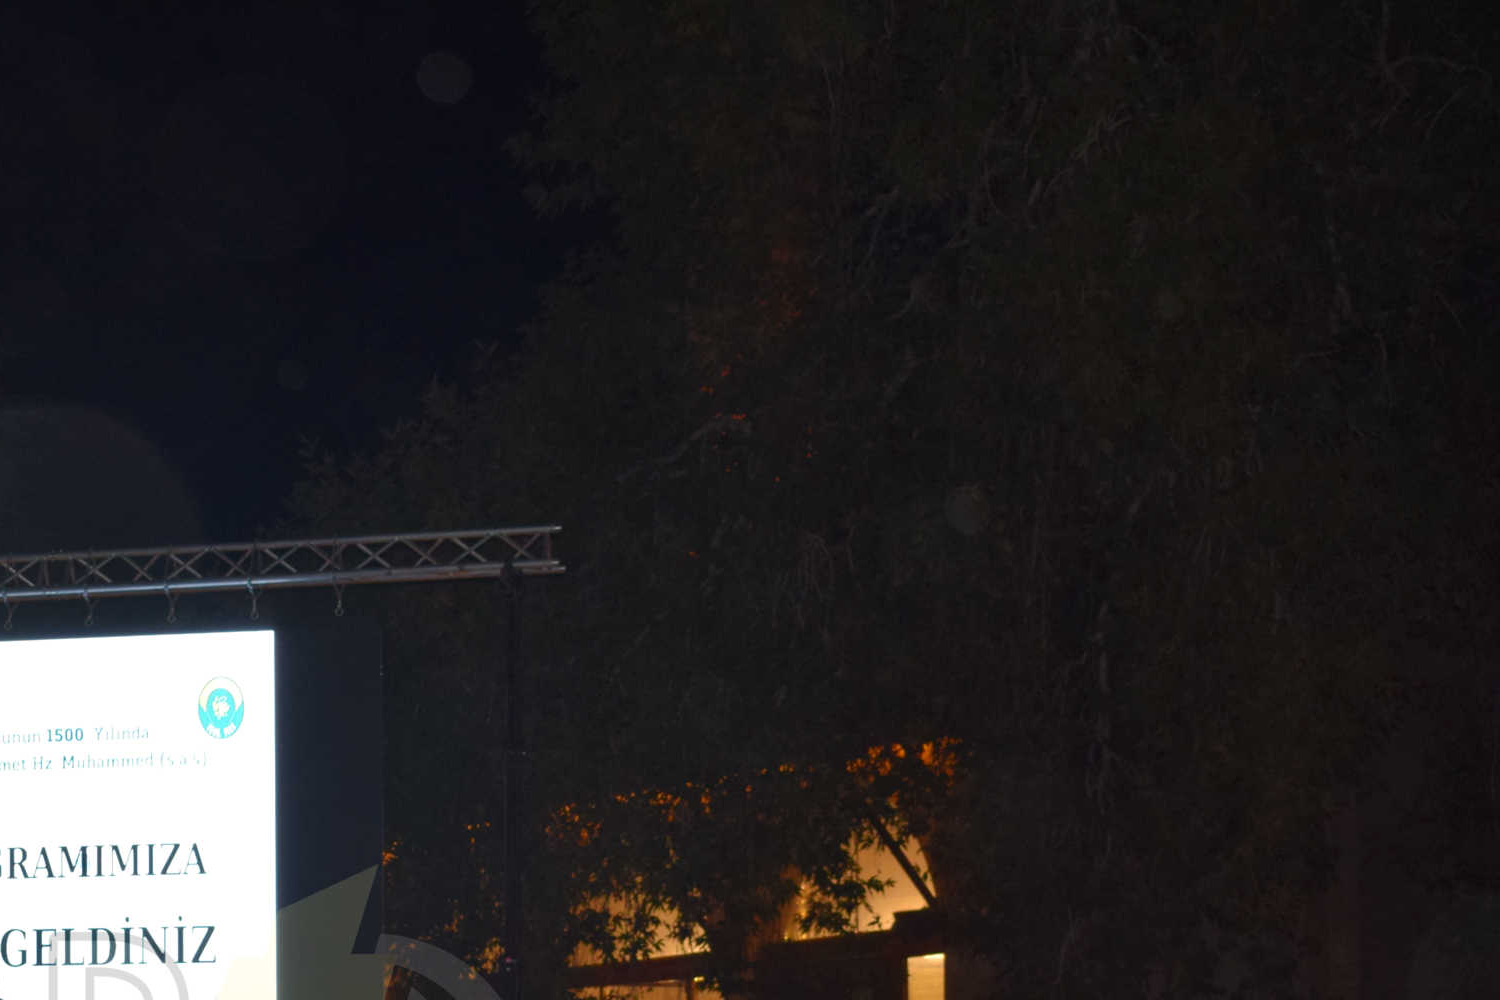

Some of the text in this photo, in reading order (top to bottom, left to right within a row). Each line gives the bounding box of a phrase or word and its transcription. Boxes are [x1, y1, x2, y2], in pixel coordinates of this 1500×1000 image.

[47, 727, 84, 743] 1500
[62, 752, 154, 769] Muhammed
[0, 916, 216, 968] GELDİNİZ
